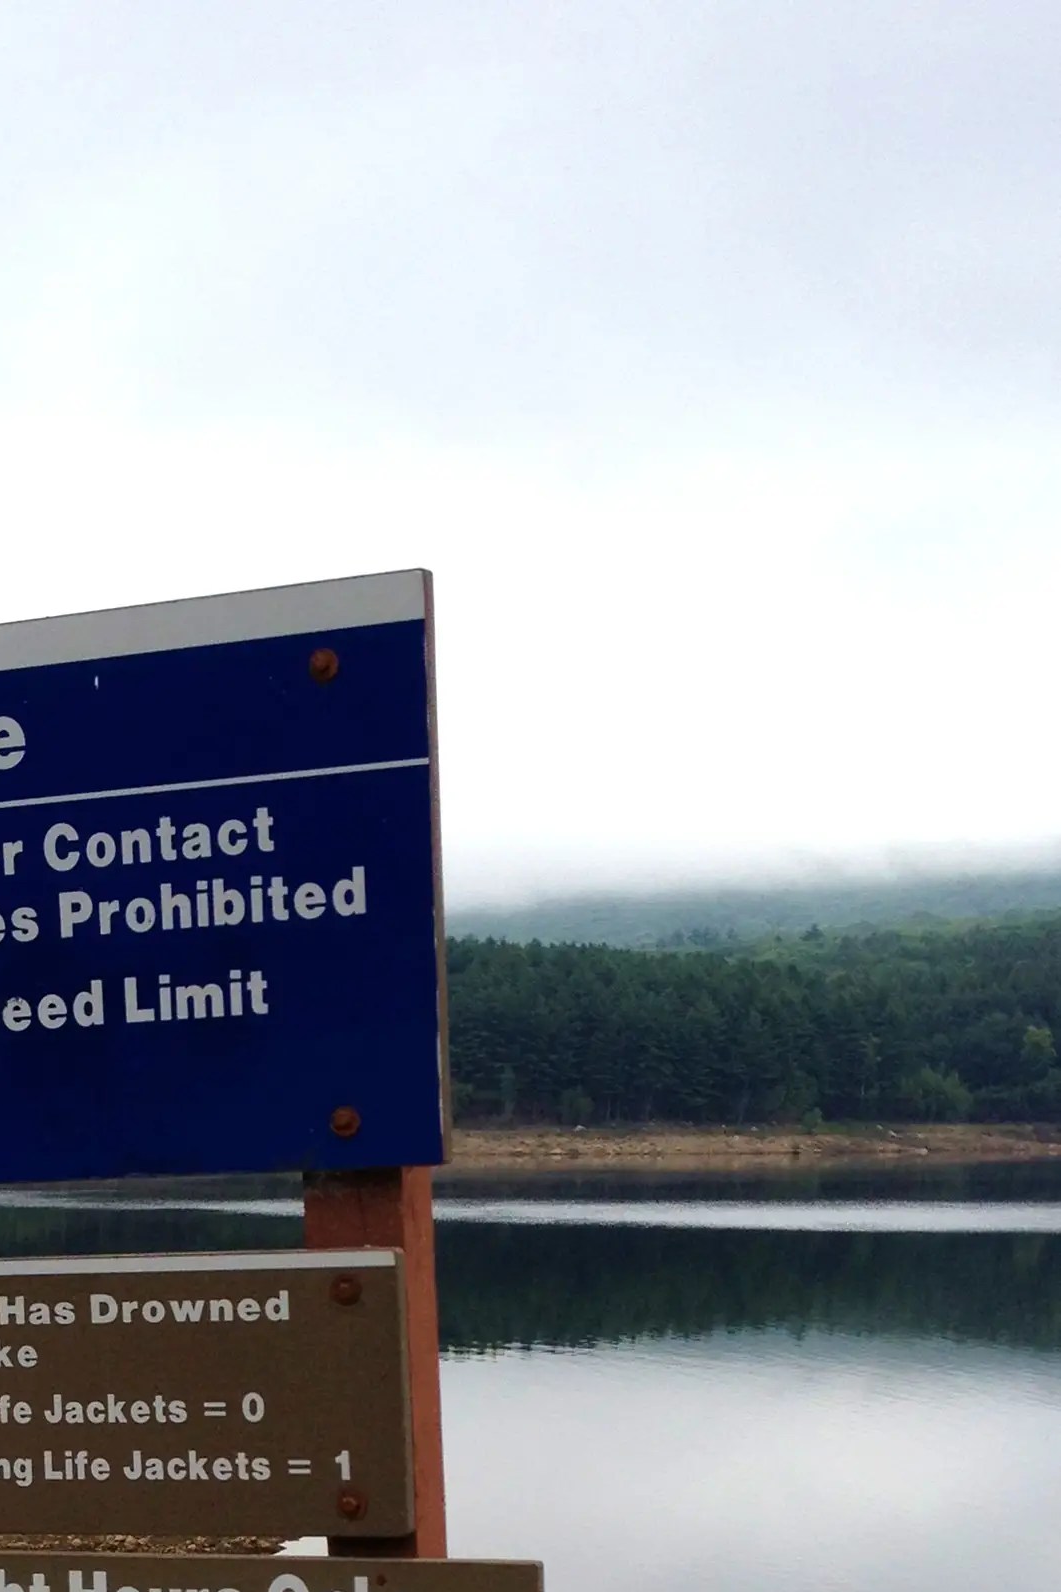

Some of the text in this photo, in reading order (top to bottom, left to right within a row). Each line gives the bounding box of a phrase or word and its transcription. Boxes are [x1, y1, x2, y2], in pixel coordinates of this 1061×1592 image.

[43, 806, 275, 872] Contact
[58, 865, 367, 939] Prohibited
[123, 969, 269, 1024] Limit
[89, 1289, 290, 1324] Drowned
[43, 1393, 188, 1424] Jackets
[203, 1401, 227, 1417] =
[241, 1391, 265, 1423] 0
[43, 1450, 111, 1481] Life
[122, 1449, 271, 1481] Jackets
[287, 1459, 312, 1475] =
[334, 1449, 351, 1481] 1
